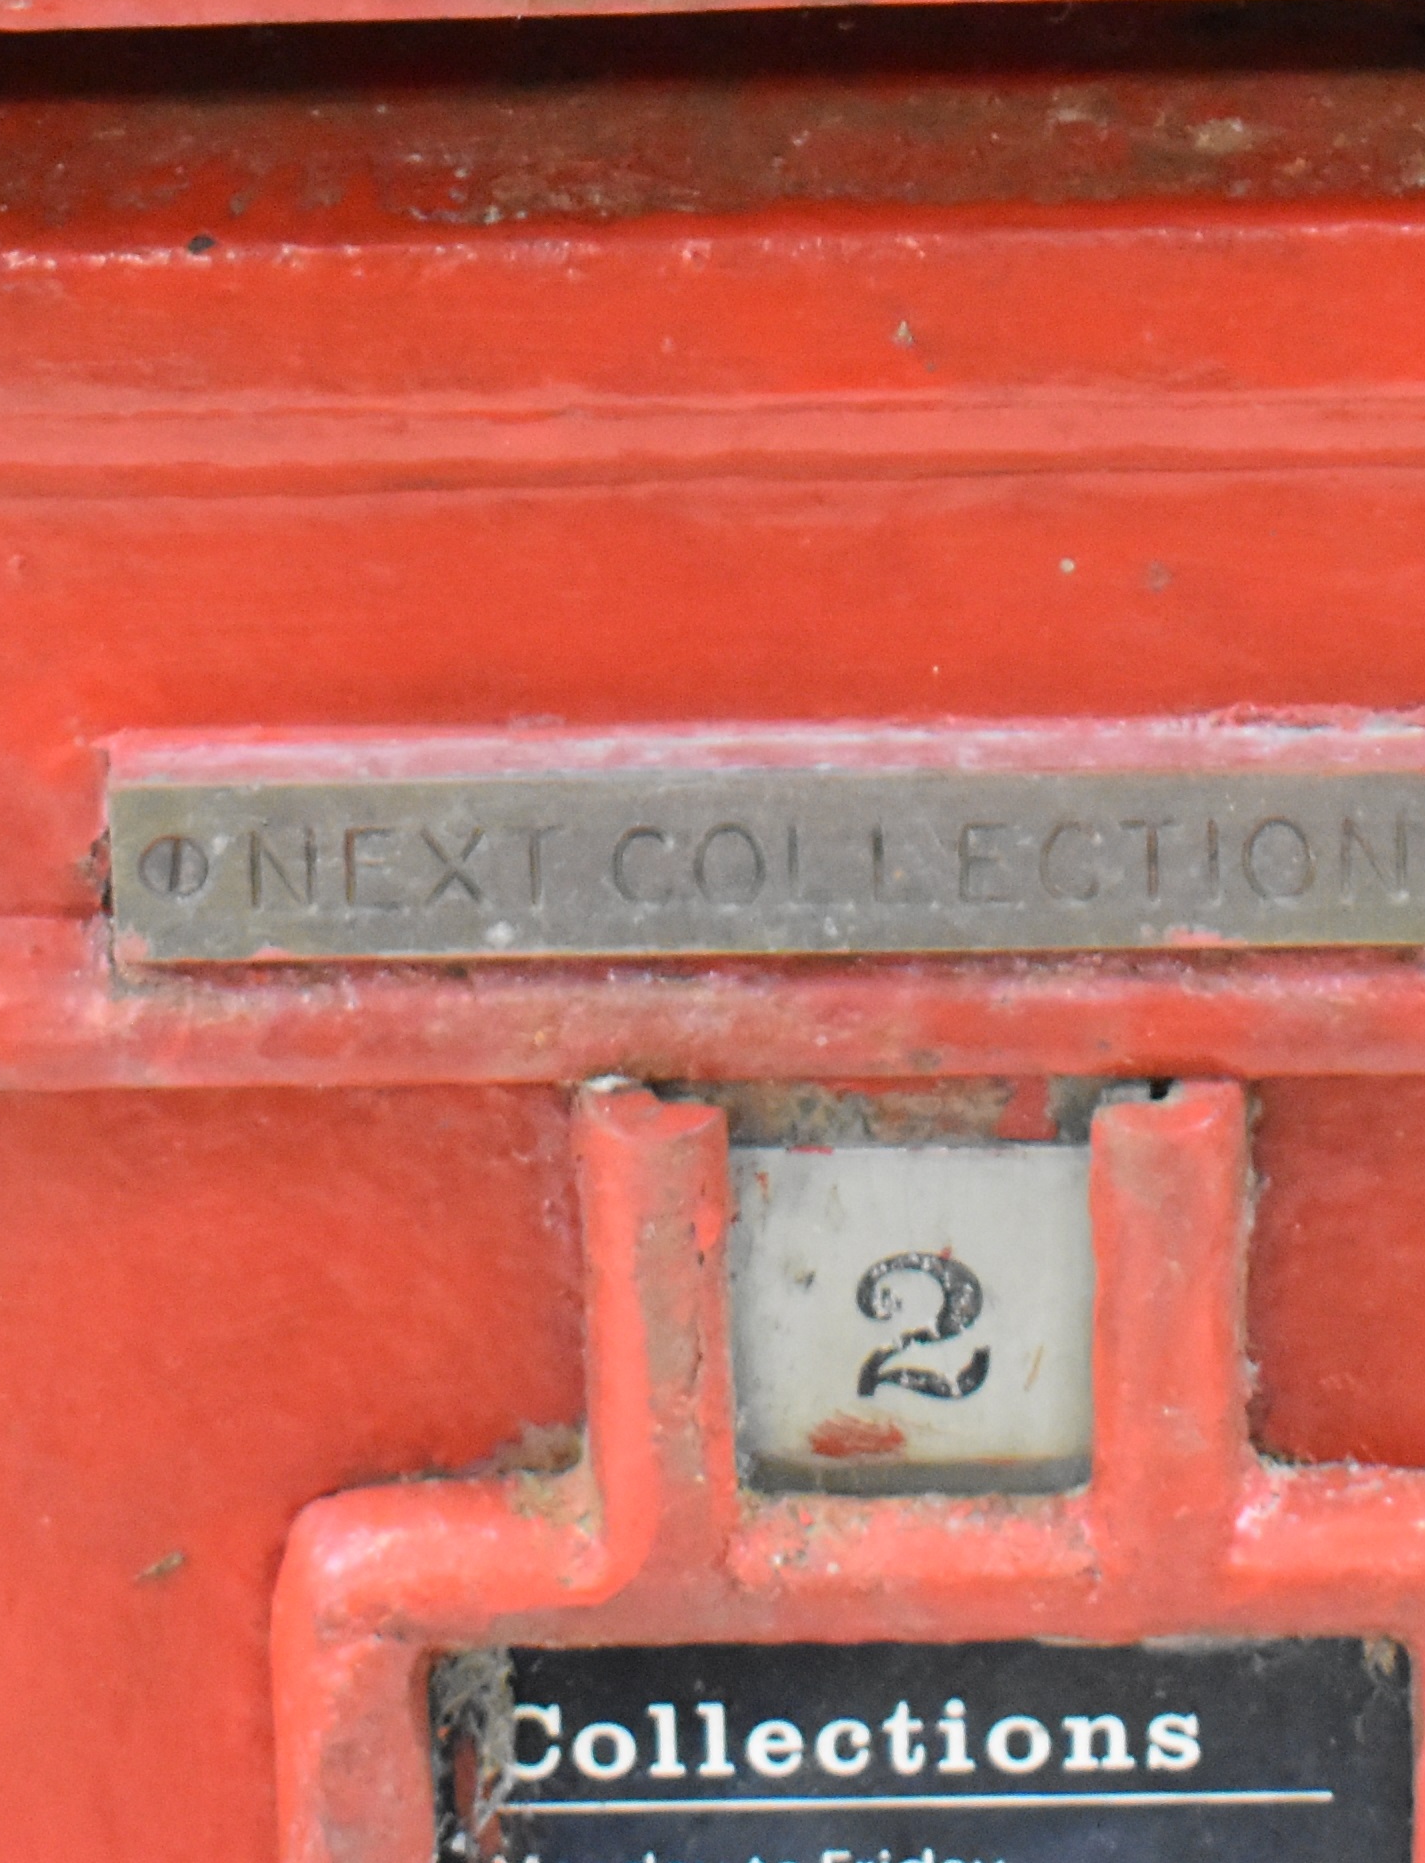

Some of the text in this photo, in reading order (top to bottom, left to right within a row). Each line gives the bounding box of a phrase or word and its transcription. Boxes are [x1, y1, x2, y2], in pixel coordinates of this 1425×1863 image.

[248, 813, 1409, 908] NEXT COLLECTION
[856, 1250, 991, 1400] 2
[511, 1697, 1203, 1781] Collections
